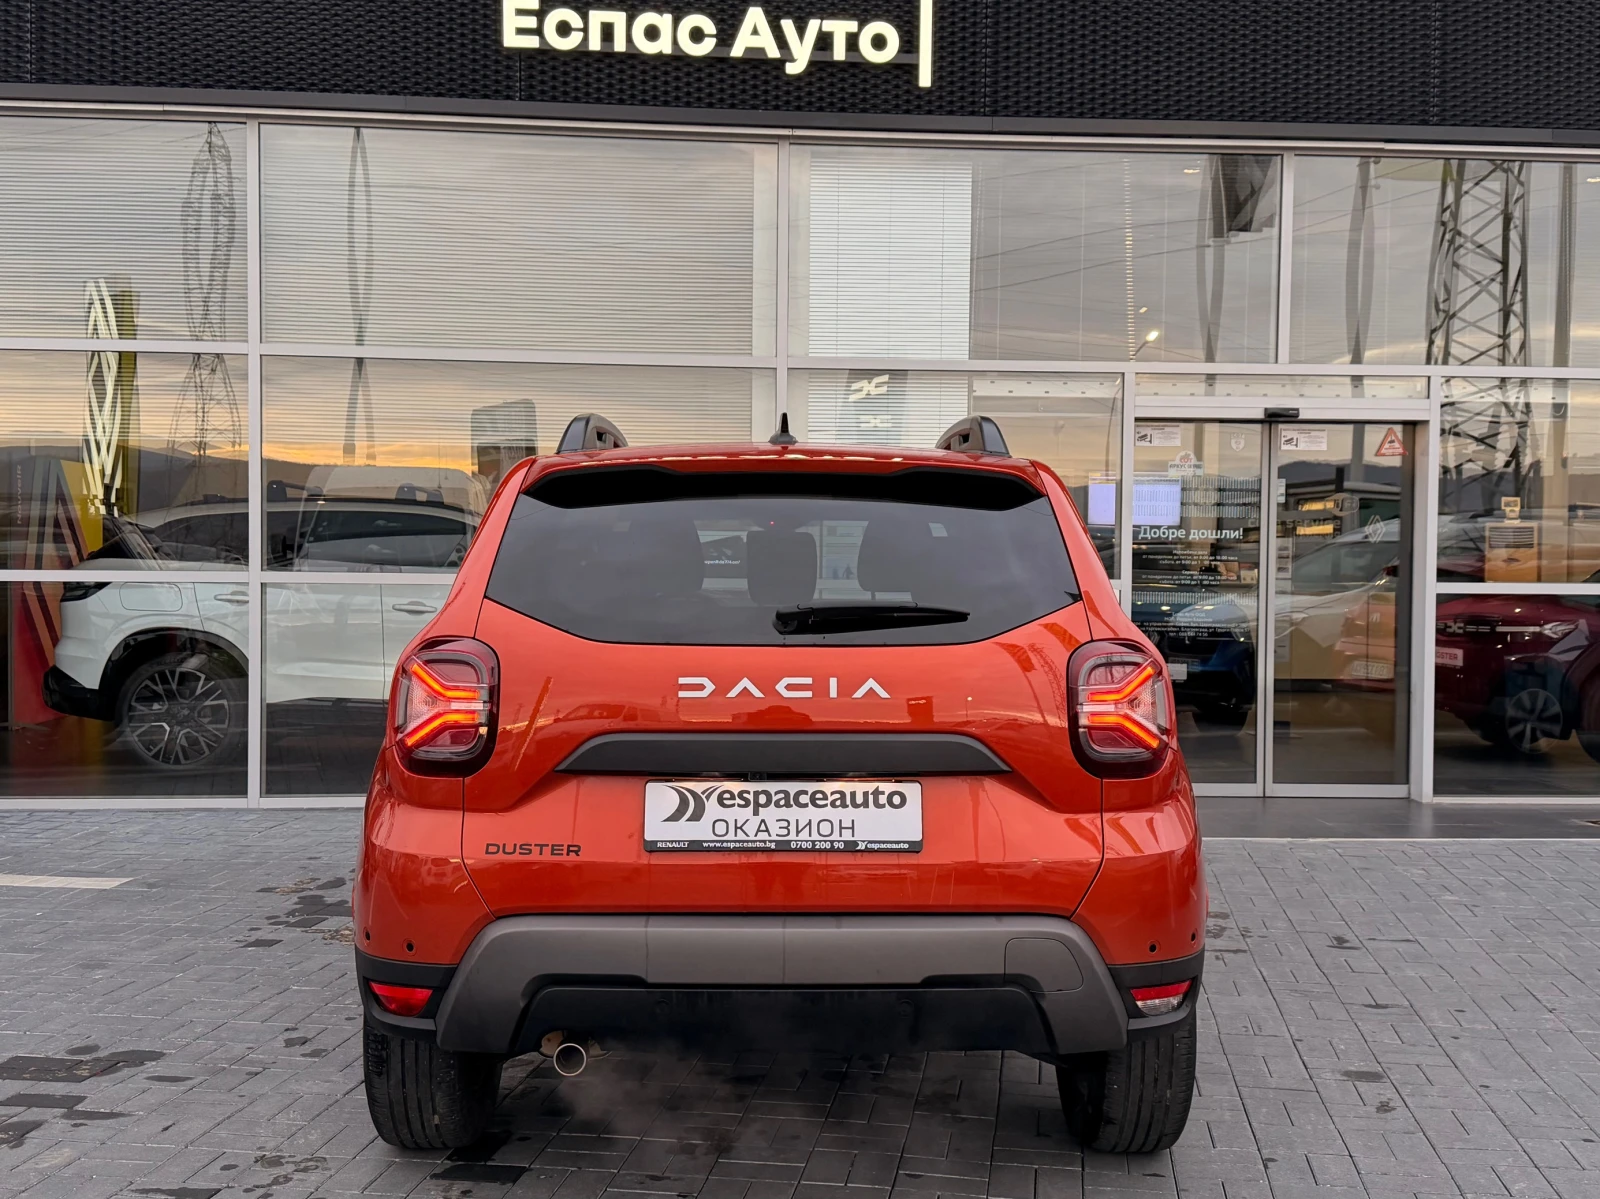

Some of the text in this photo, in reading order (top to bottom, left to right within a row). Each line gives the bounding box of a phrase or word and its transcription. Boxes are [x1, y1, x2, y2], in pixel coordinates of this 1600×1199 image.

[502, 0, 900, 75] Еспас Ауто
[1139, 526, 1243, 540] Добре дошли!
[677, 676, 892, 700] DACIA
[716, 786, 907, 816] espaceauto
[711, 818, 856, 838] ОКАЗИОН
[485, 843, 582, 857] DUSTER
[702, 841, 777, 850] www.espaceauto.bg
[790, 841, 813, 849] 0700
[814, 841, 832, 849] 200
[833, 841, 845, 849] 90
[867, 842, 909, 850] espaceauto
